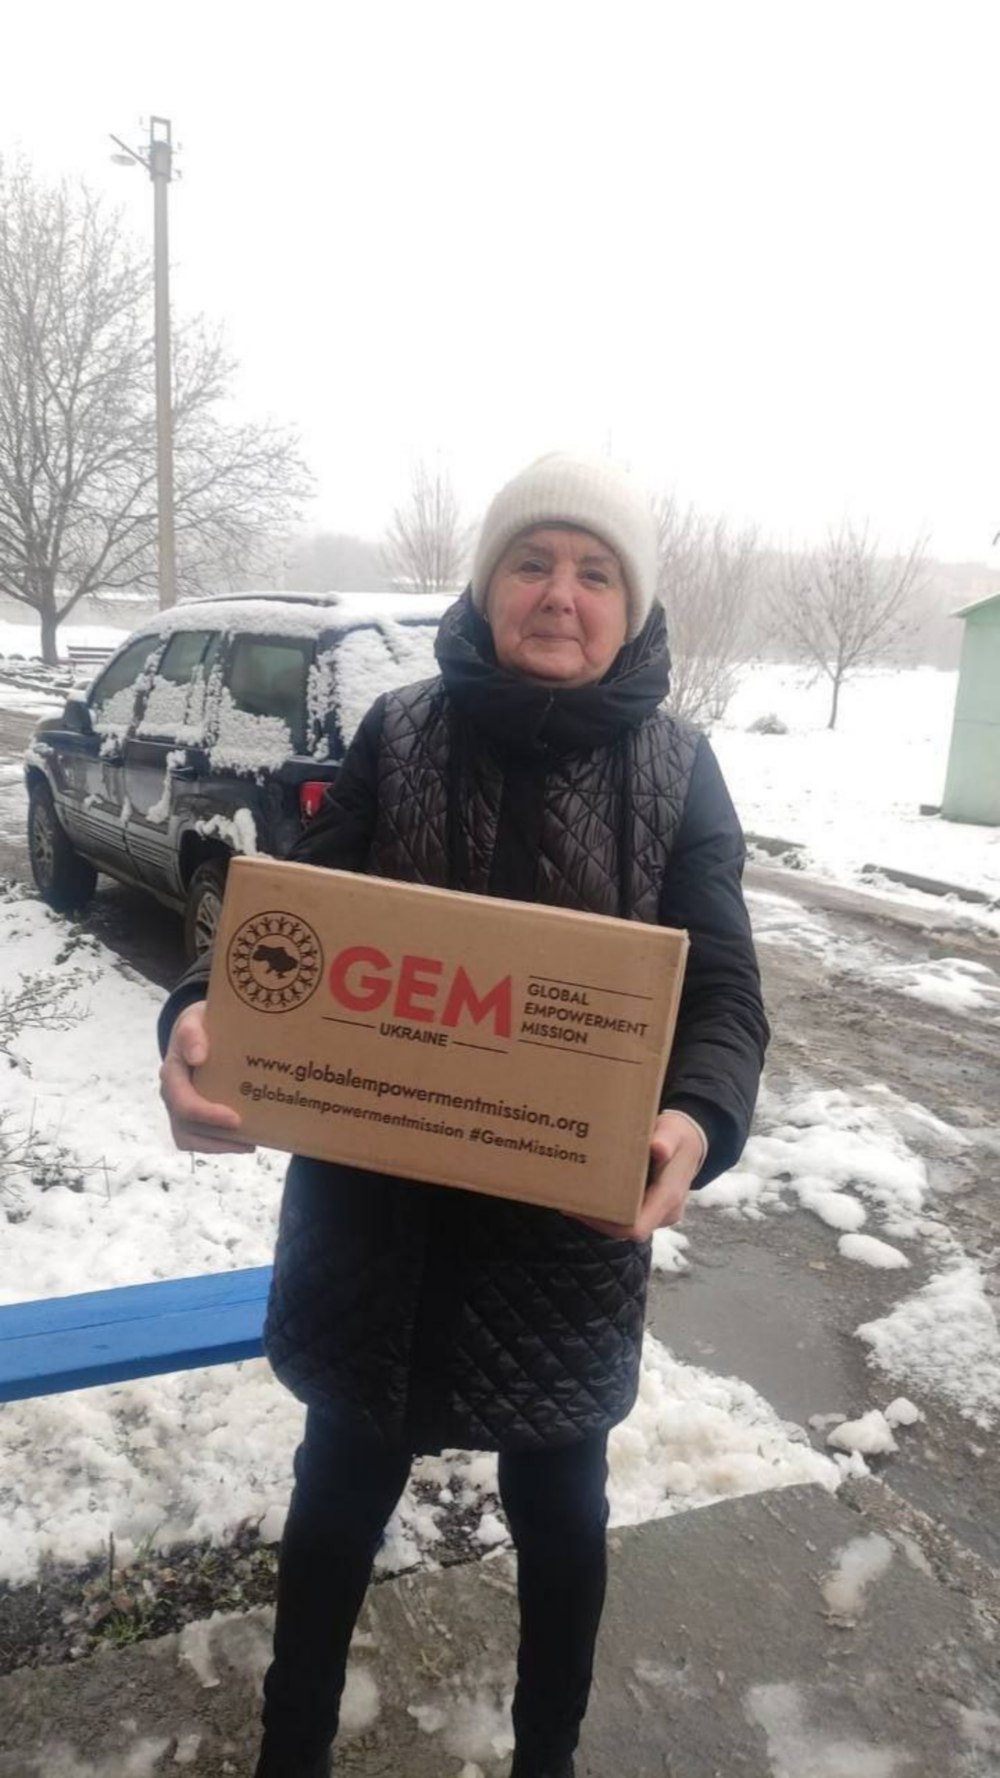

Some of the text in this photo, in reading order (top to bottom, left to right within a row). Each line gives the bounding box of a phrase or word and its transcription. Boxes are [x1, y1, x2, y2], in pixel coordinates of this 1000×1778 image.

[328, 945, 513, 1038] GEM
[526, 982, 590, 1006] GLOBAL
[379, 1022, 449, 1048] UKRAINE
[520, 1021, 589, 1045] MISSION
[523, 1002, 649, 1037] EMPOWERMENT
[246, 1054, 590, 1138] www.globalempowermentmission.org
[239, 1080, 588, 1165] @globalempowermentmission #GemMissions
